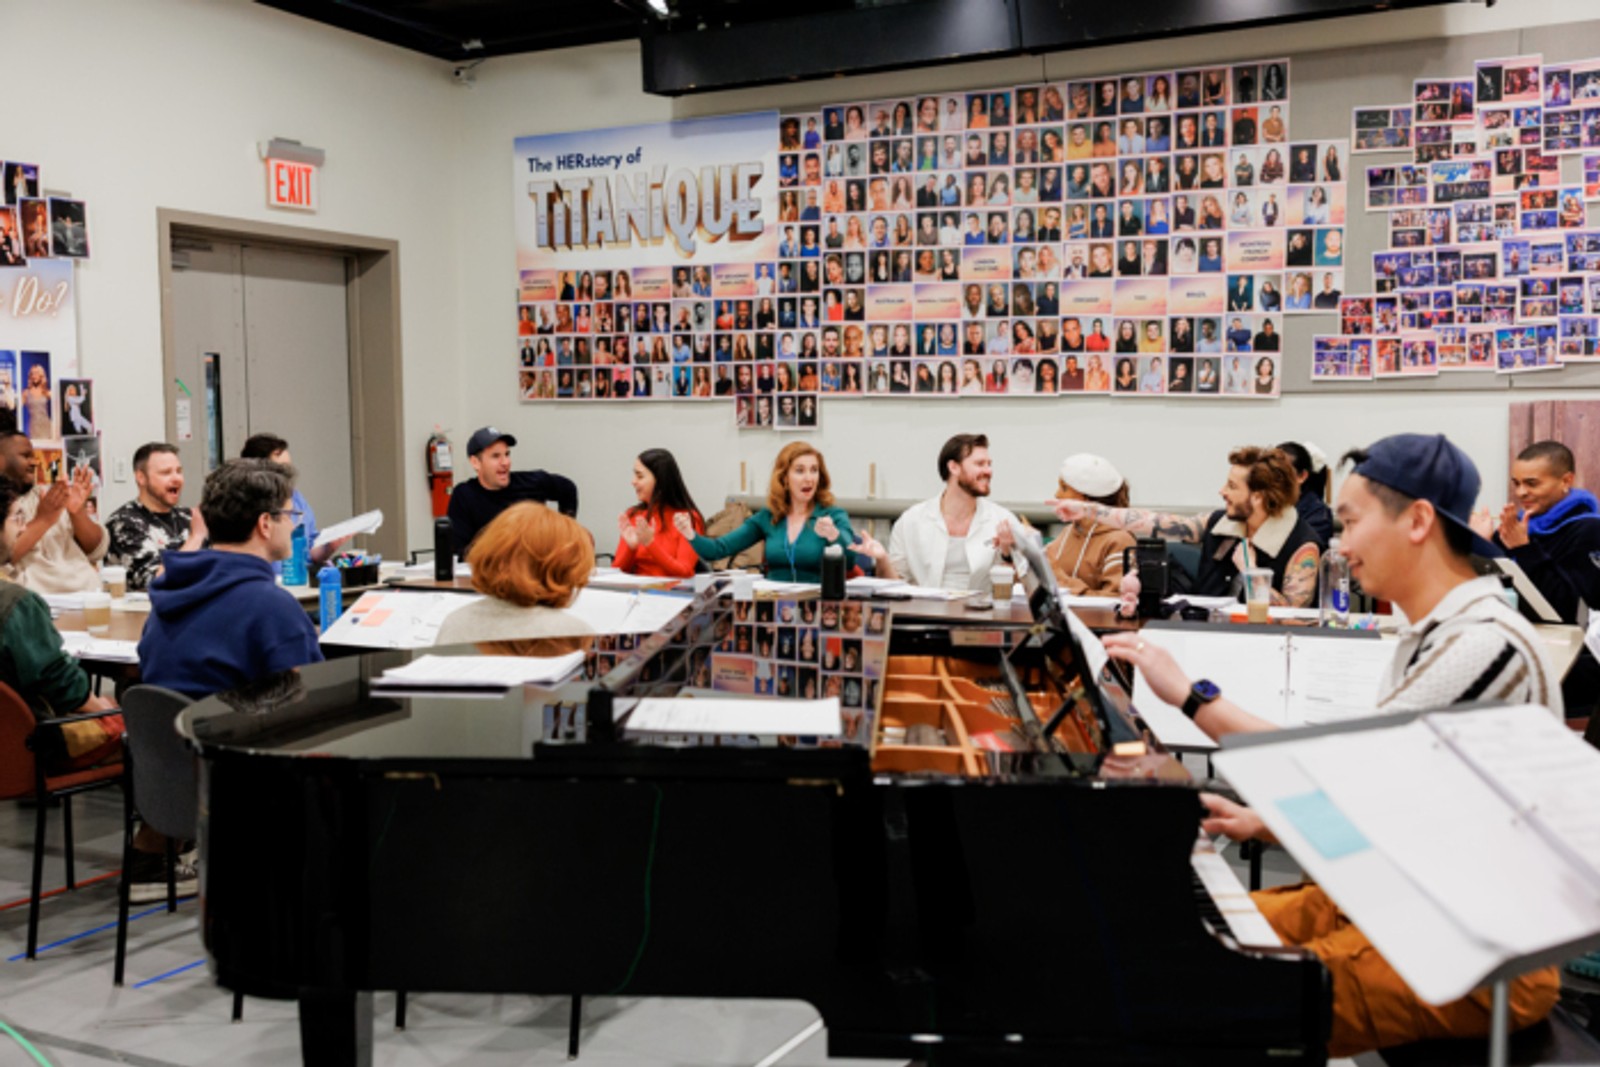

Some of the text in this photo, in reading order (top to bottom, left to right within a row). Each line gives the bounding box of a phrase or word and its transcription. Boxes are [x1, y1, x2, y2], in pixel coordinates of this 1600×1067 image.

[527, 146, 643, 172] The HERstory of
[275, 163, 312, 206] EXIT
[12, 276, 68, 317] Do?
